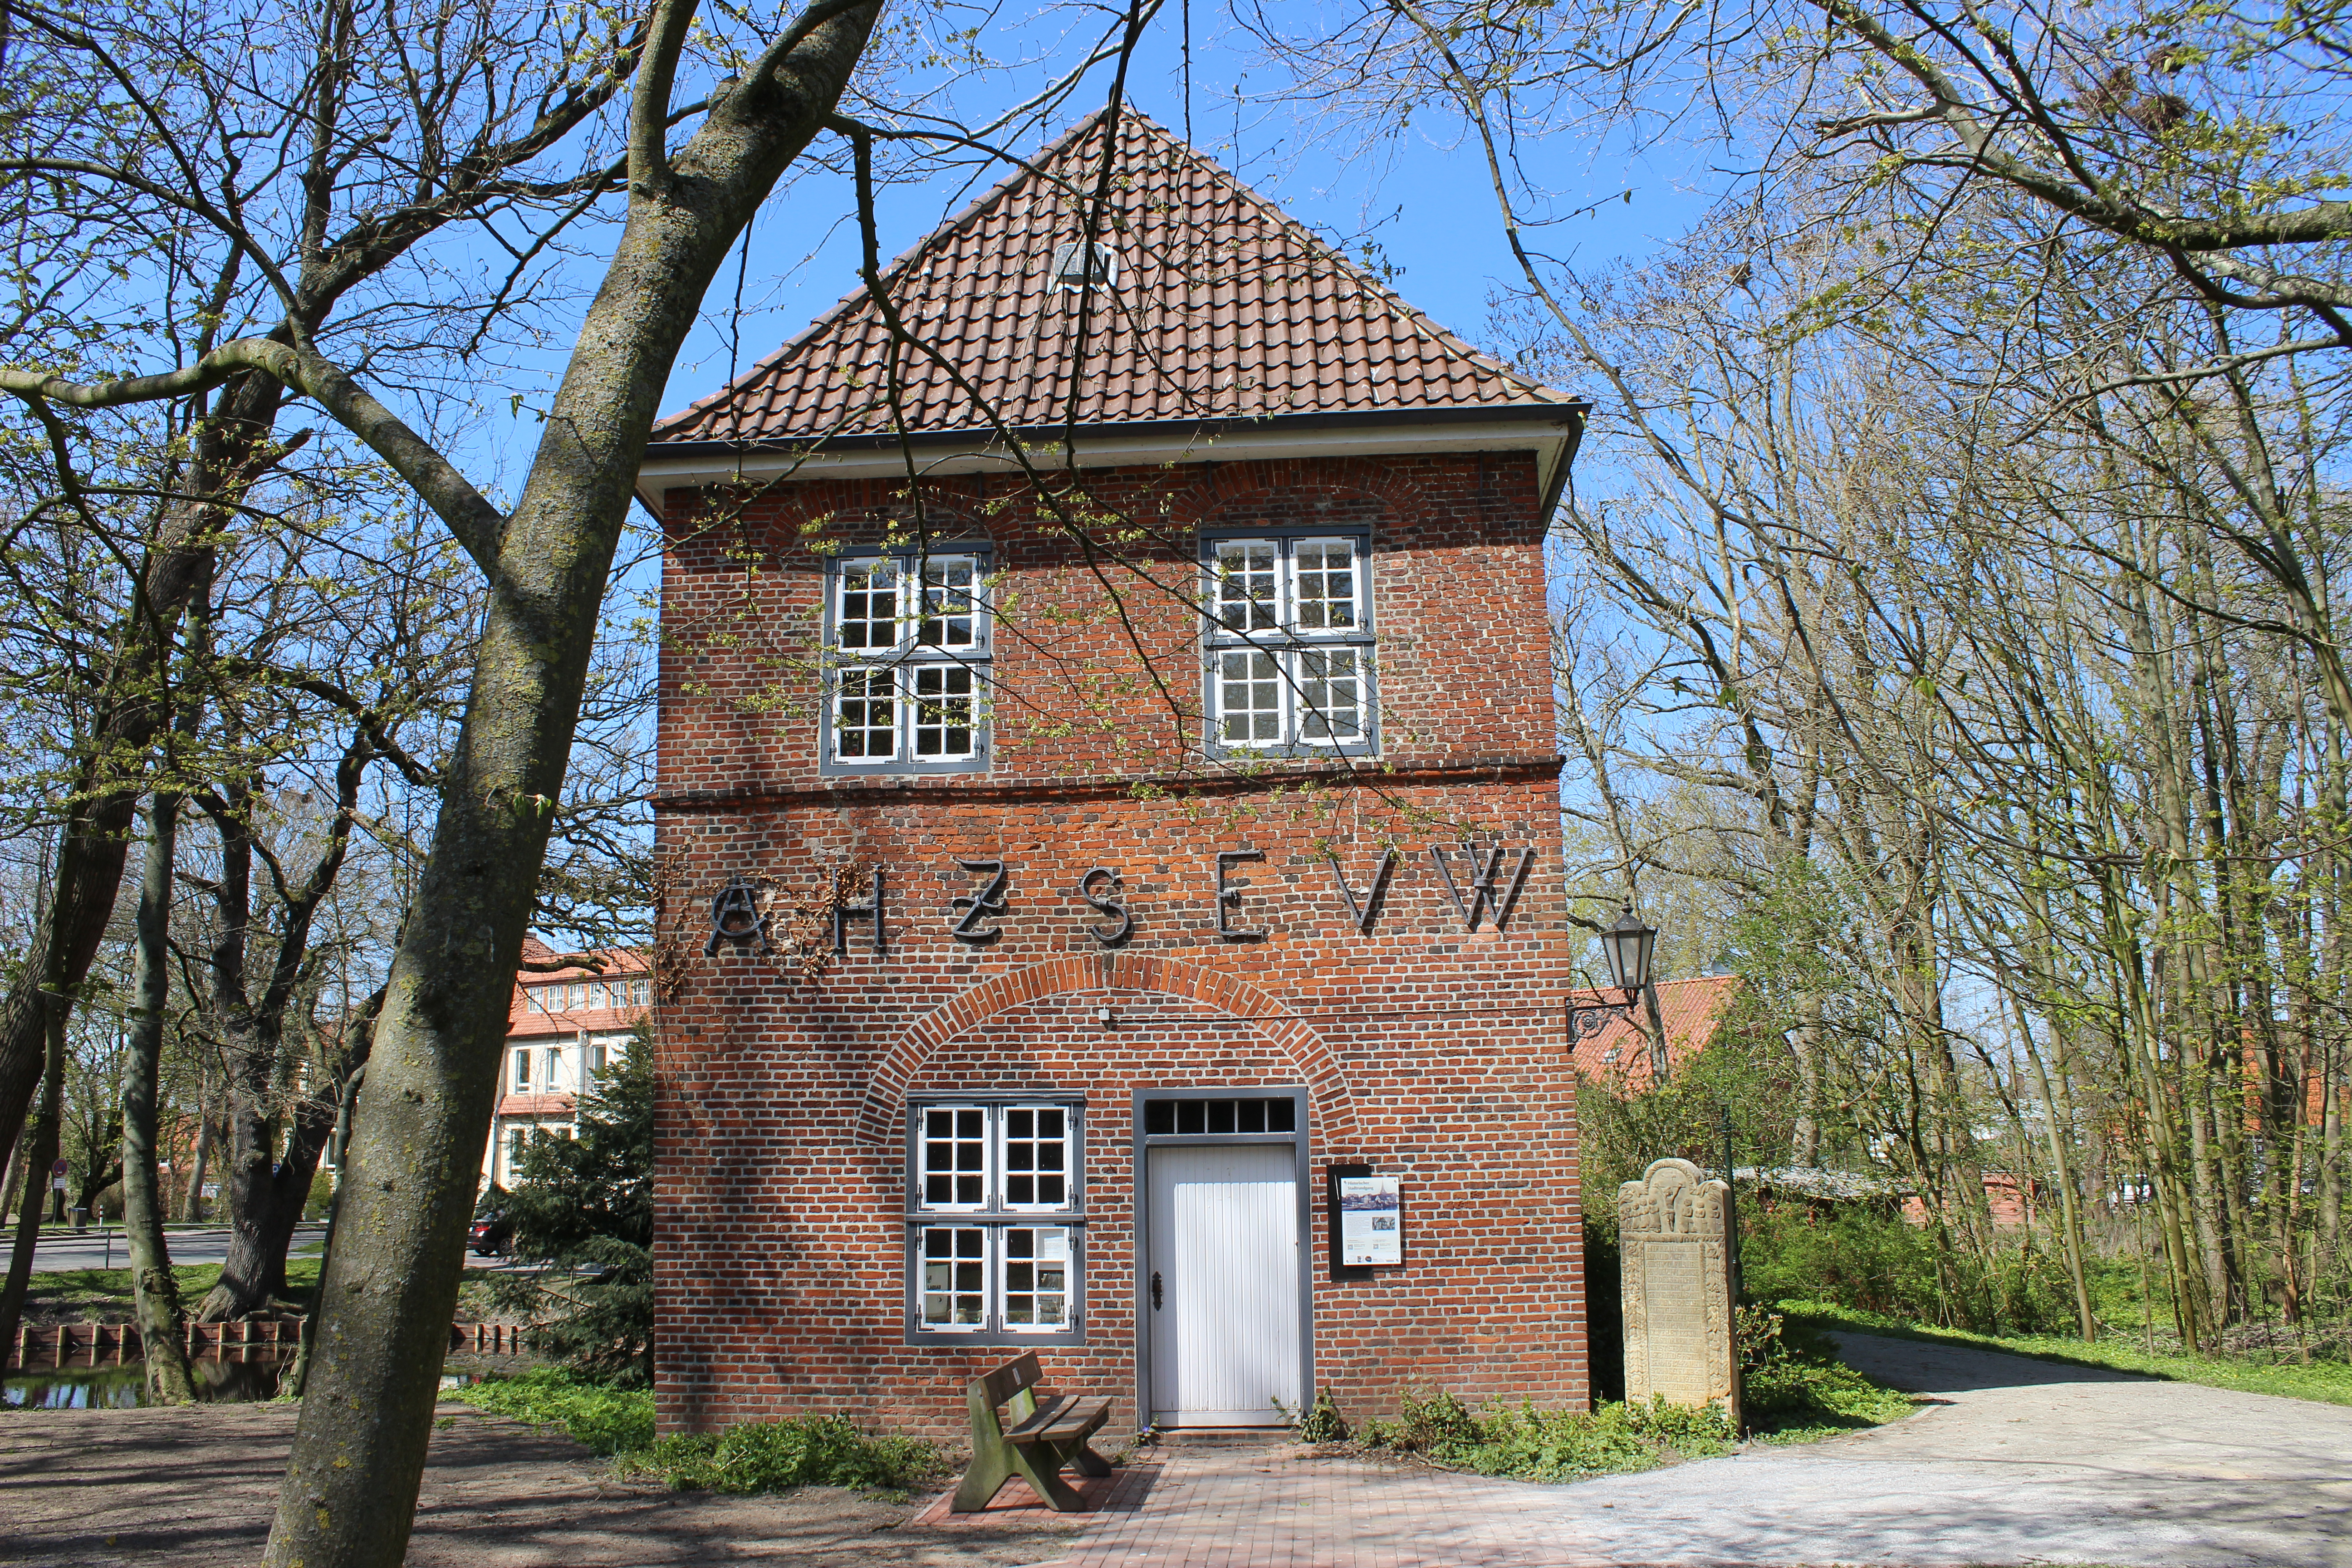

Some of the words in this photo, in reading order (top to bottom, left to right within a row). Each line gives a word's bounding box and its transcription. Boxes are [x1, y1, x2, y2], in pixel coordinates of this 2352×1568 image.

[833, 864, 882, 949] H
[951, 856, 1005, 937] Z
[1081, 866, 1129, 941] S
[1216, 848, 1264, 936] E
[1327, 846, 1395, 927] V
[1430, 842, 1533, 924] W
